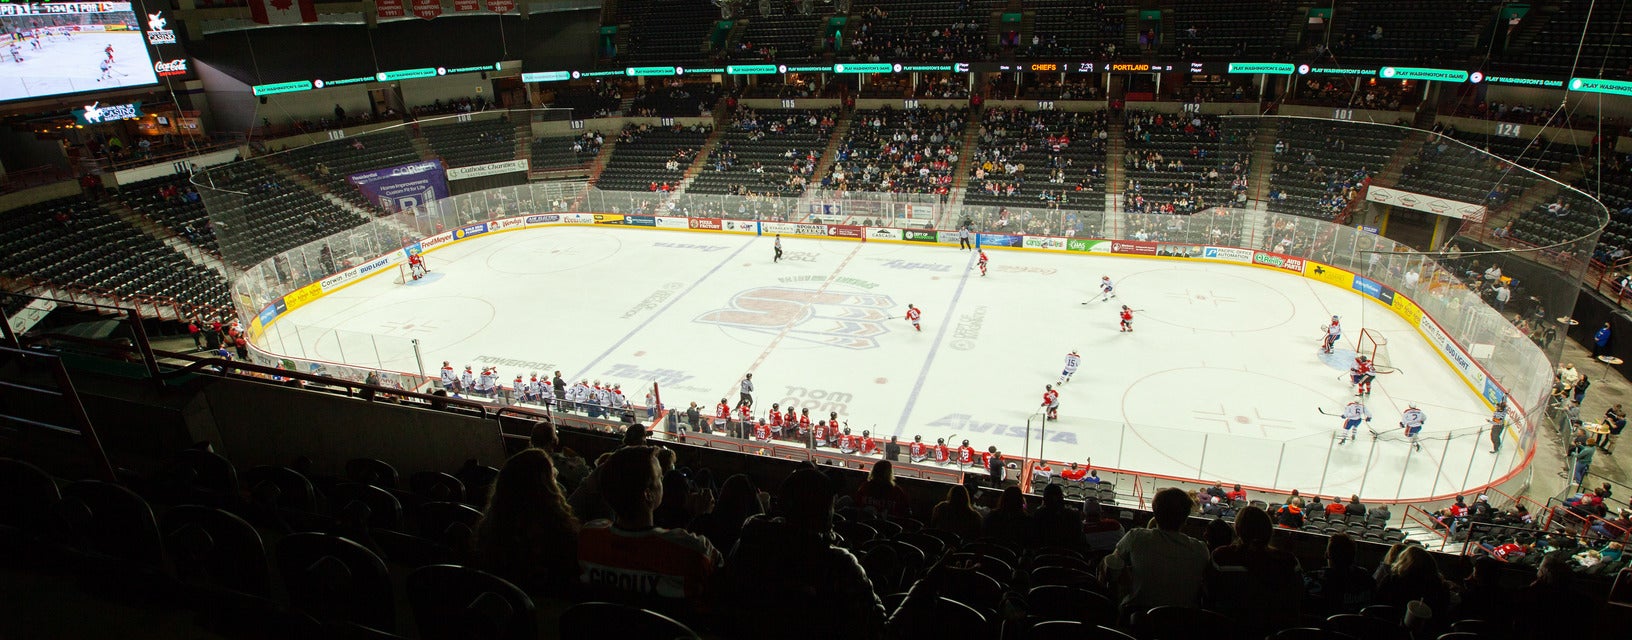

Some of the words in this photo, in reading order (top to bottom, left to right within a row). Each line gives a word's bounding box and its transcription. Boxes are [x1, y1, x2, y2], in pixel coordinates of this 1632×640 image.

[155, 59, 187, 72] Coca-Cola
[782, 100, 795, 108] 105
[904, 100, 918, 108] 104
[1038, 101, 1054, 110] 103
[1183, 104, 1200, 113] 102
[103, 108, 135, 118] CASINO
[1335, 109, 1352, 120] 101
[571, 120, 584, 129] 107
[1499, 123, 1520, 137] 124
[460, 165, 486, 174] Catholic
[396, 179, 429, 189] Improvements
[360, 264, 372, 274] BUD
[372, 258, 389, 270] LIGHT
[321, 276, 343, 288] Corwin
[345, 269, 358, 280] Ford
[1445, 343, 1456, 357] BUD
[1454, 352, 1470, 370] LIGHT
[473, 355, 557, 371] POWERADE
[1067, 358, 1076, 368] 15
[784, 385, 853, 403] nom
[924, 412, 1078, 445] AVISTA
[590, 566, 660, 594] GIROUX
